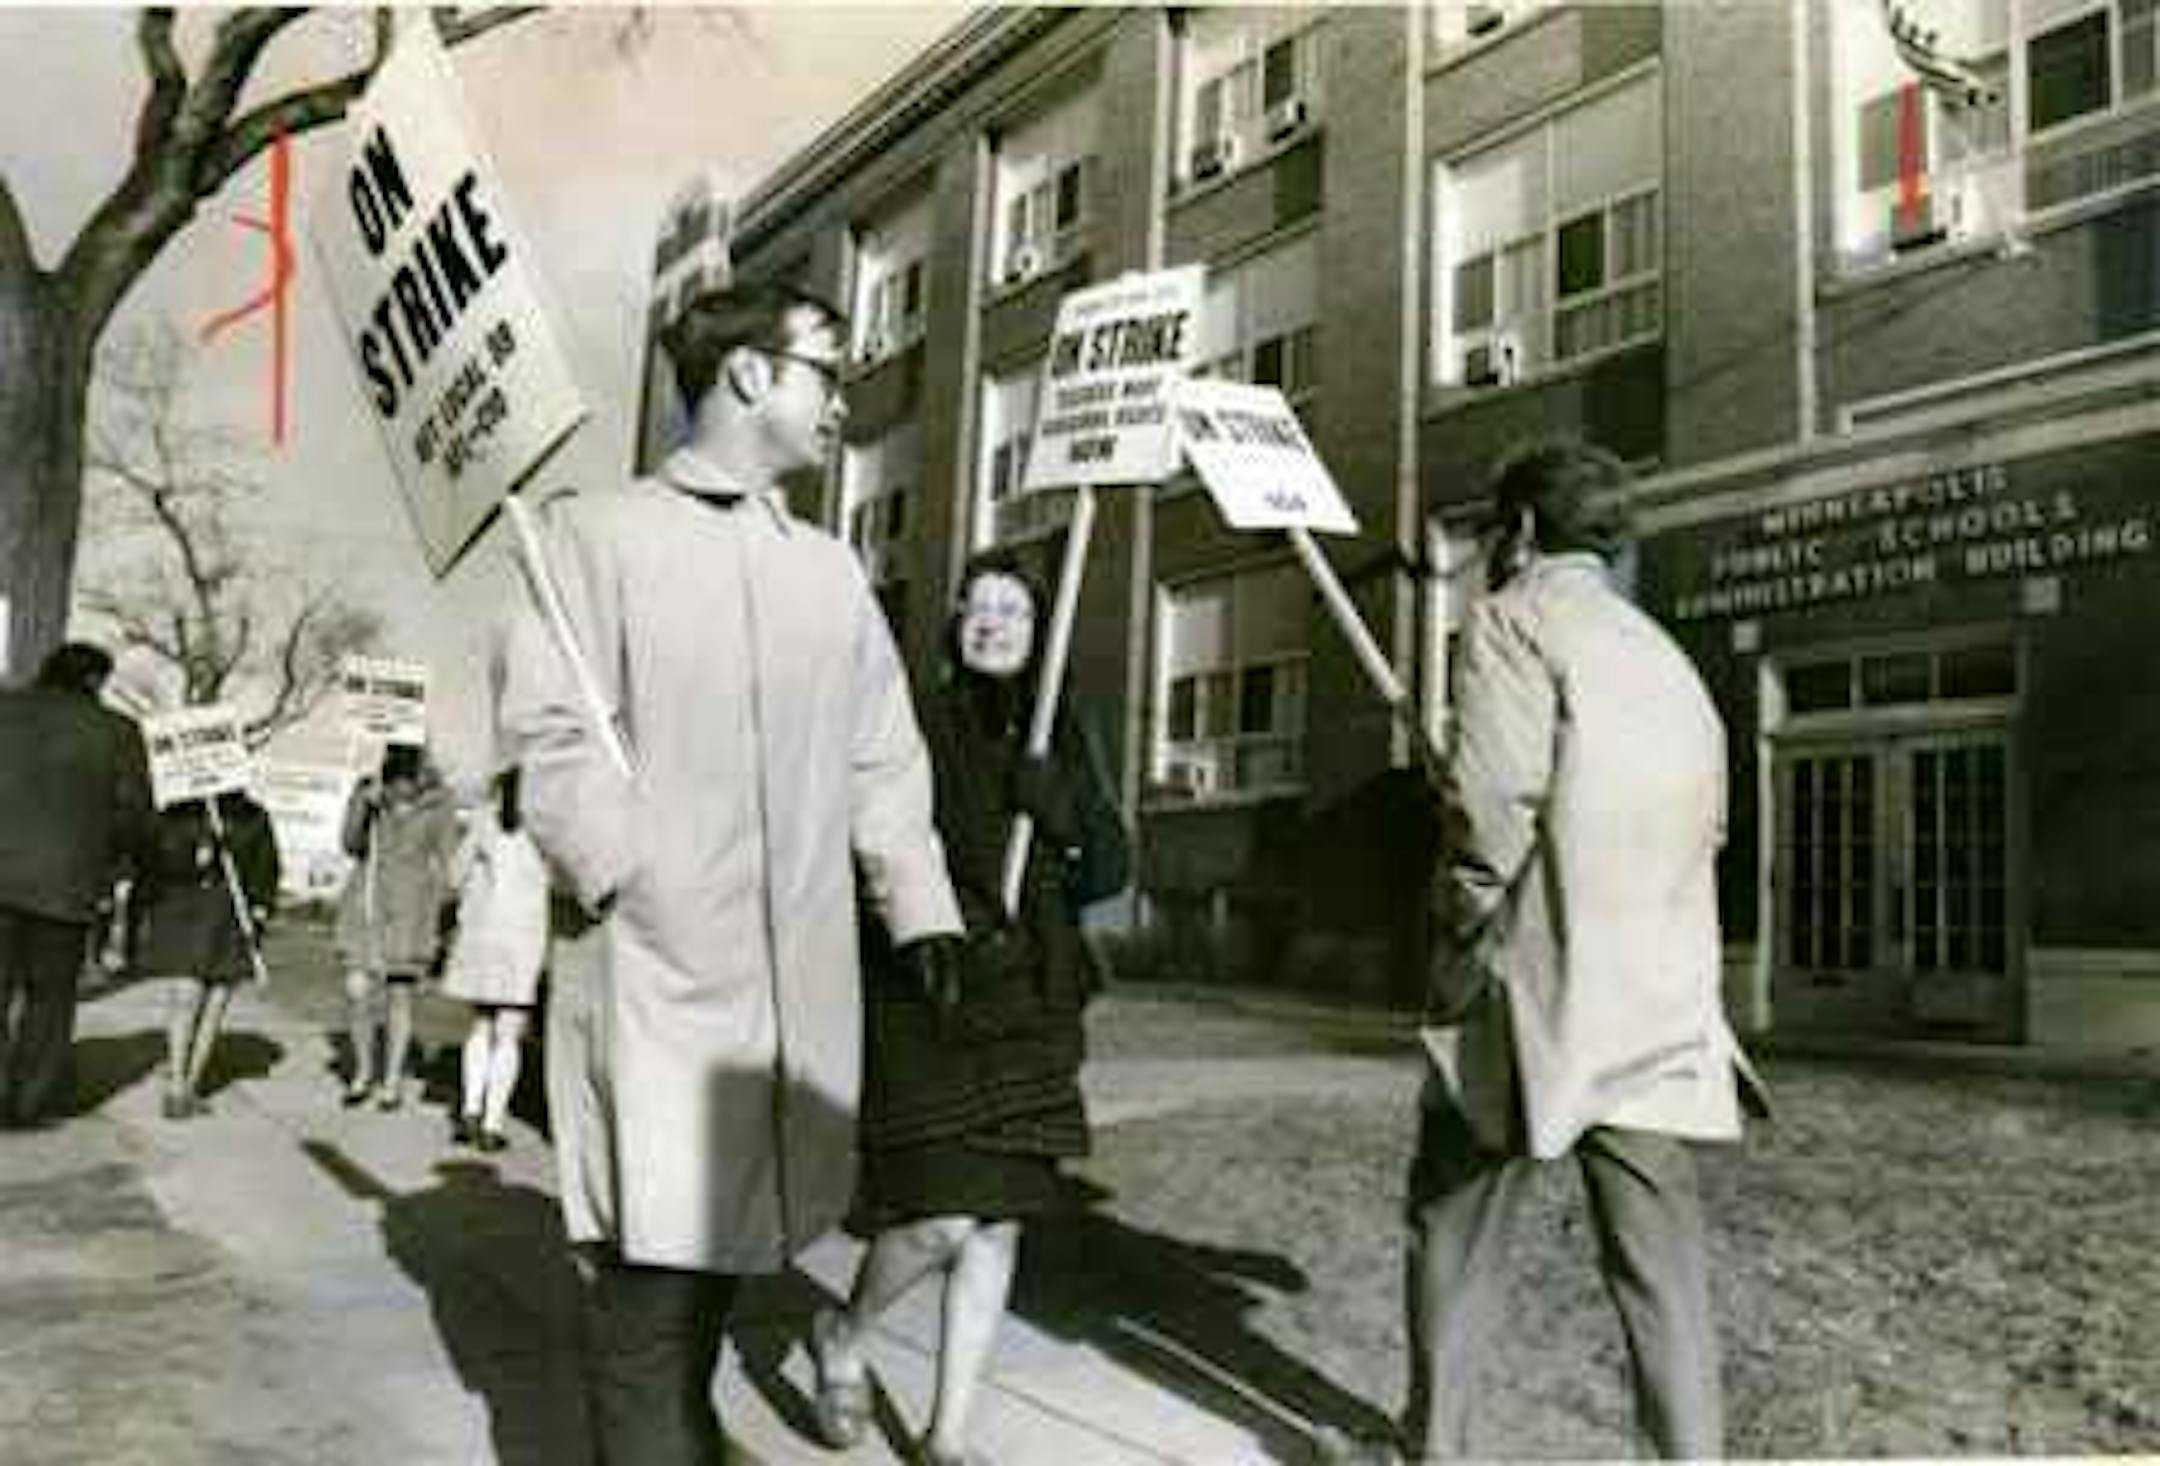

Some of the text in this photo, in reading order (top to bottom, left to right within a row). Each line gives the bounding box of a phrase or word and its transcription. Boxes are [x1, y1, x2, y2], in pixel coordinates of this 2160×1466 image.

[349, 125, 413, 258] ON
[360, 170, 508, 419] STRIKE
[1050, 310, 1190, 378] ON STRIKE
[1178, 408, 1220, 441] ON
[1216, 409, 1308, 456] STRIKE
[1711, 488, 2078, 580] PUBLIC SCHOOLS
[1762, 463, 2008, 537] MINNEAPOLIS
[1965, 518, 2151, 577] BUILDING
[344, 673, 424, 703] ON STRIKE
[154, 722, 237, 756] ON STRIKE
